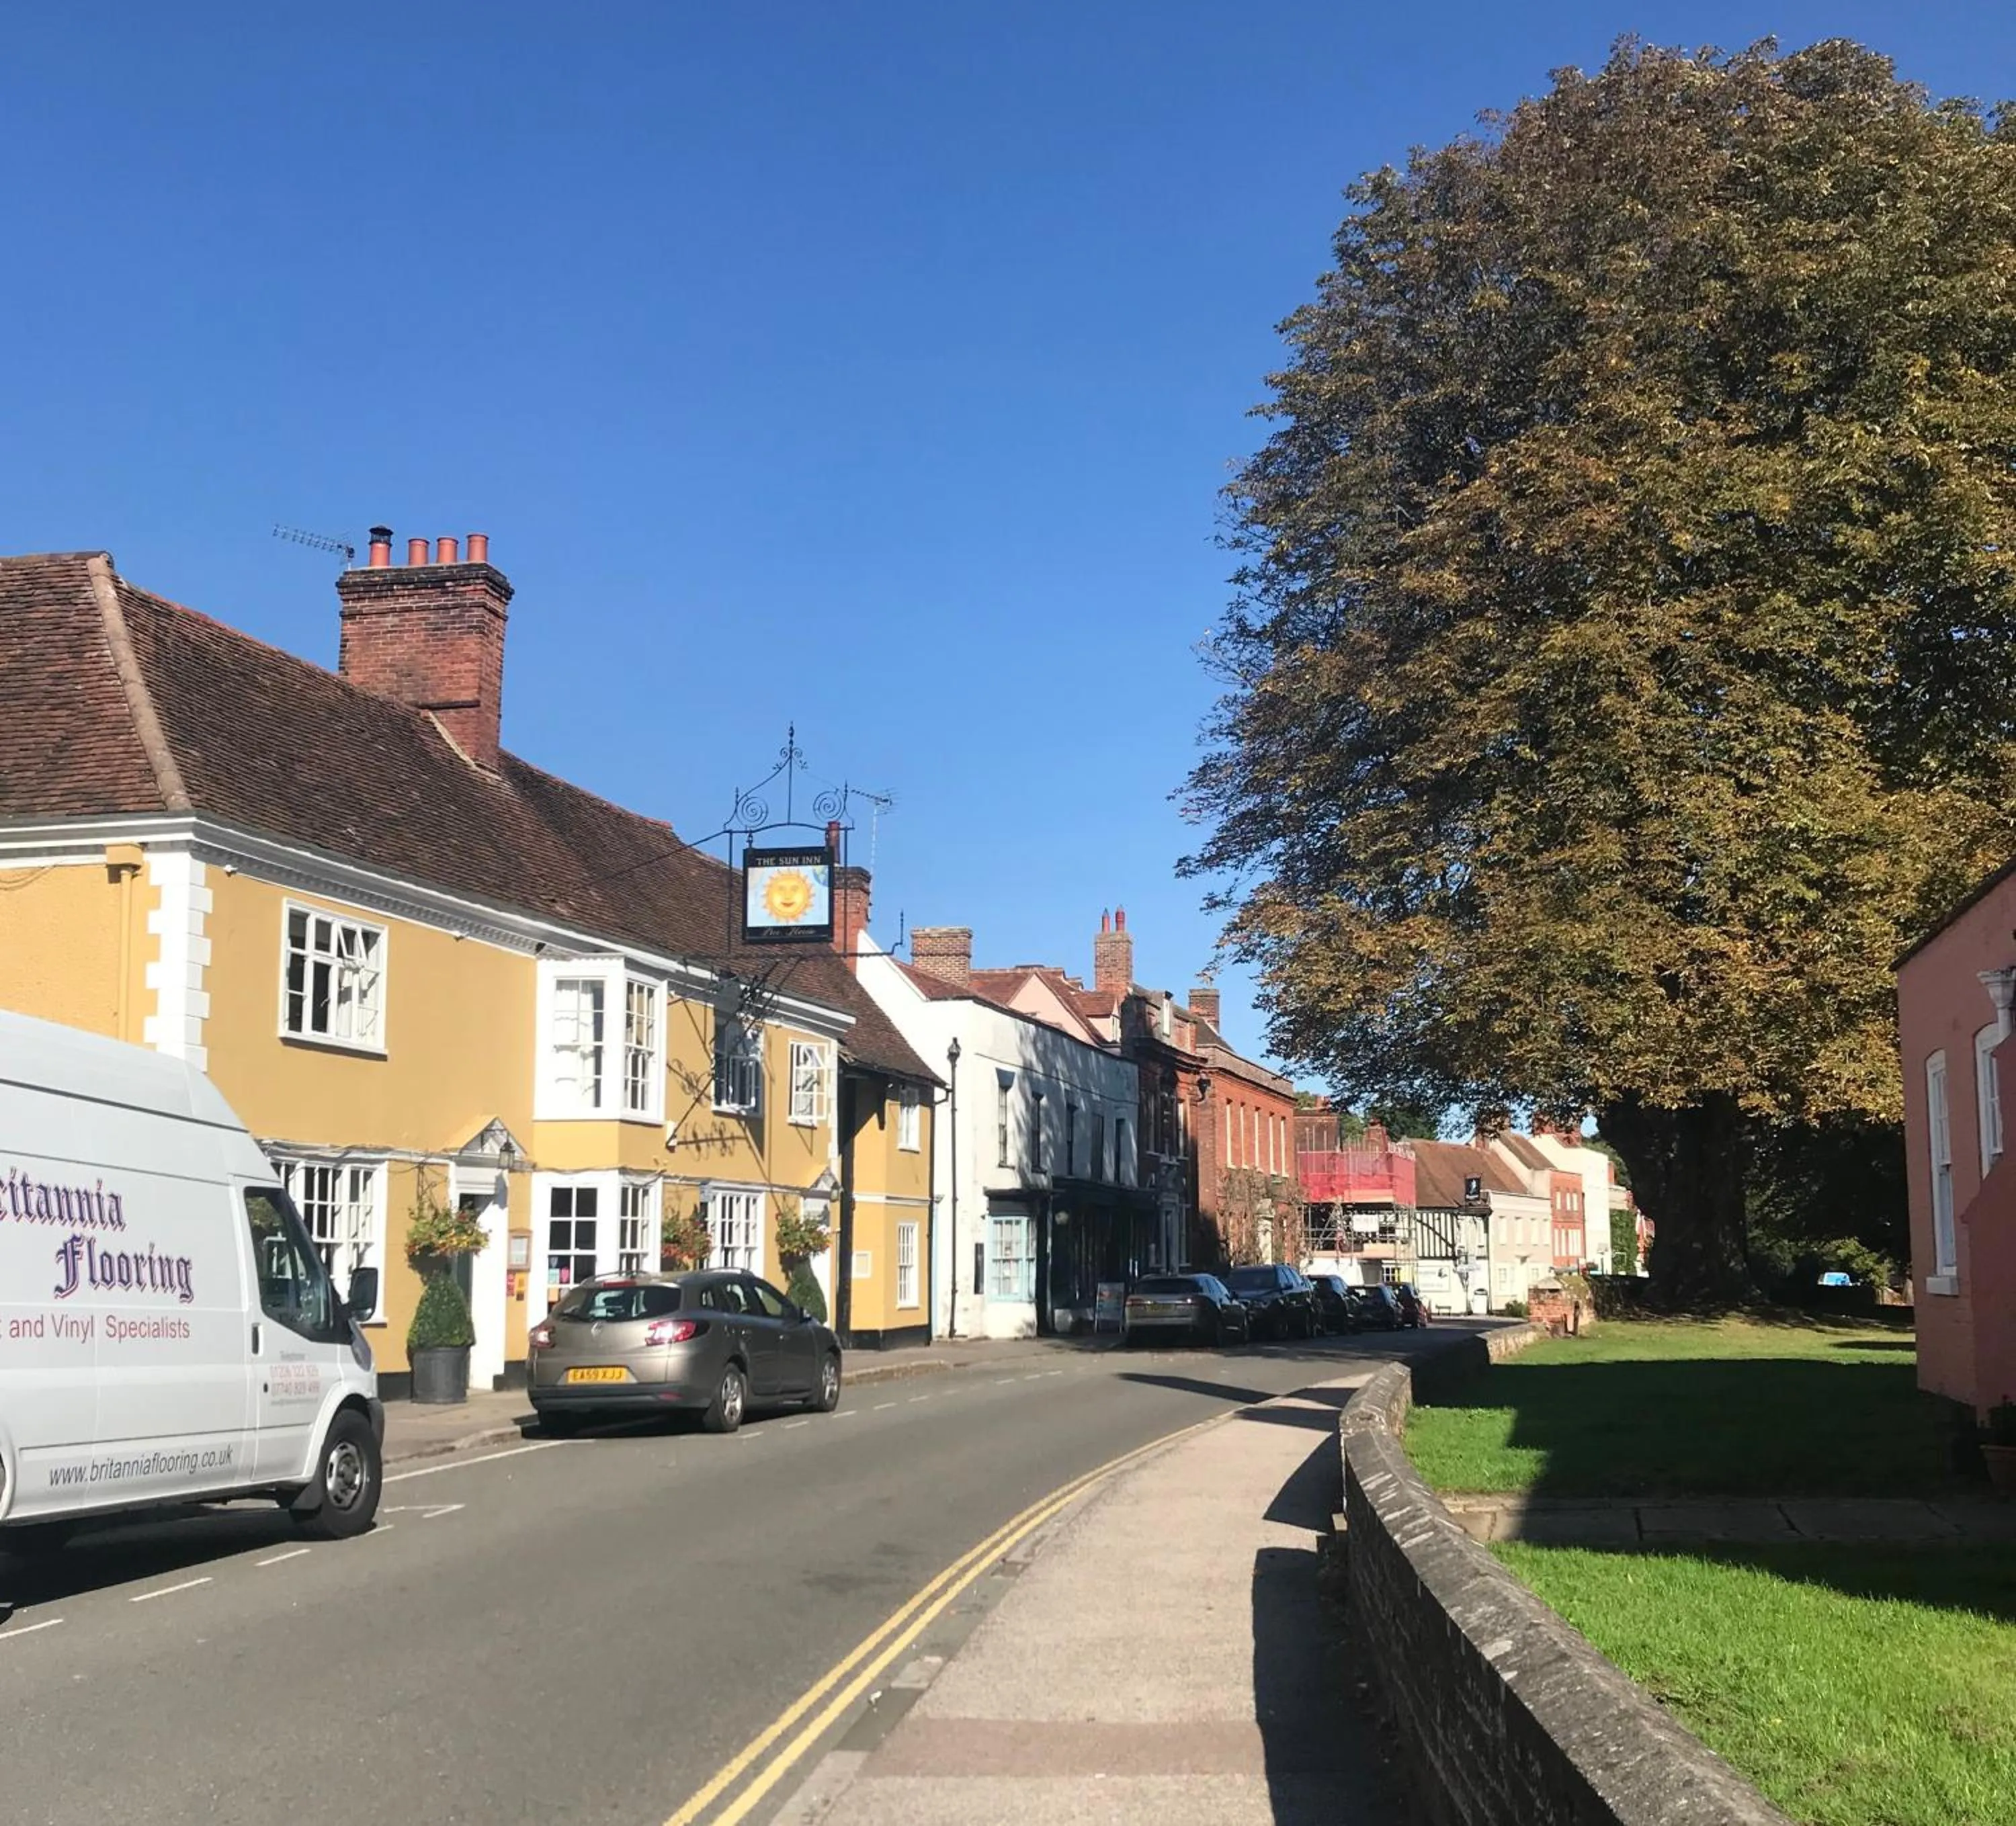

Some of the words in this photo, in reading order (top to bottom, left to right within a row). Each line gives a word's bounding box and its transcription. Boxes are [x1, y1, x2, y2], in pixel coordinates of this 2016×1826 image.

[755, 858, 776, 866] THE
[780, 857, 799, 865] SUN
[802, 855, 821, 864] INN
[54, 1233, 194, 1304] Flooring
[9, 1315, 44, 1338] and
[50, 1313, 95, 1344] Vinyl
[105, 1314, 191, 1342] Specialists
[50, 1444, 233, 1486] www.britanniaflooring.co.uk
